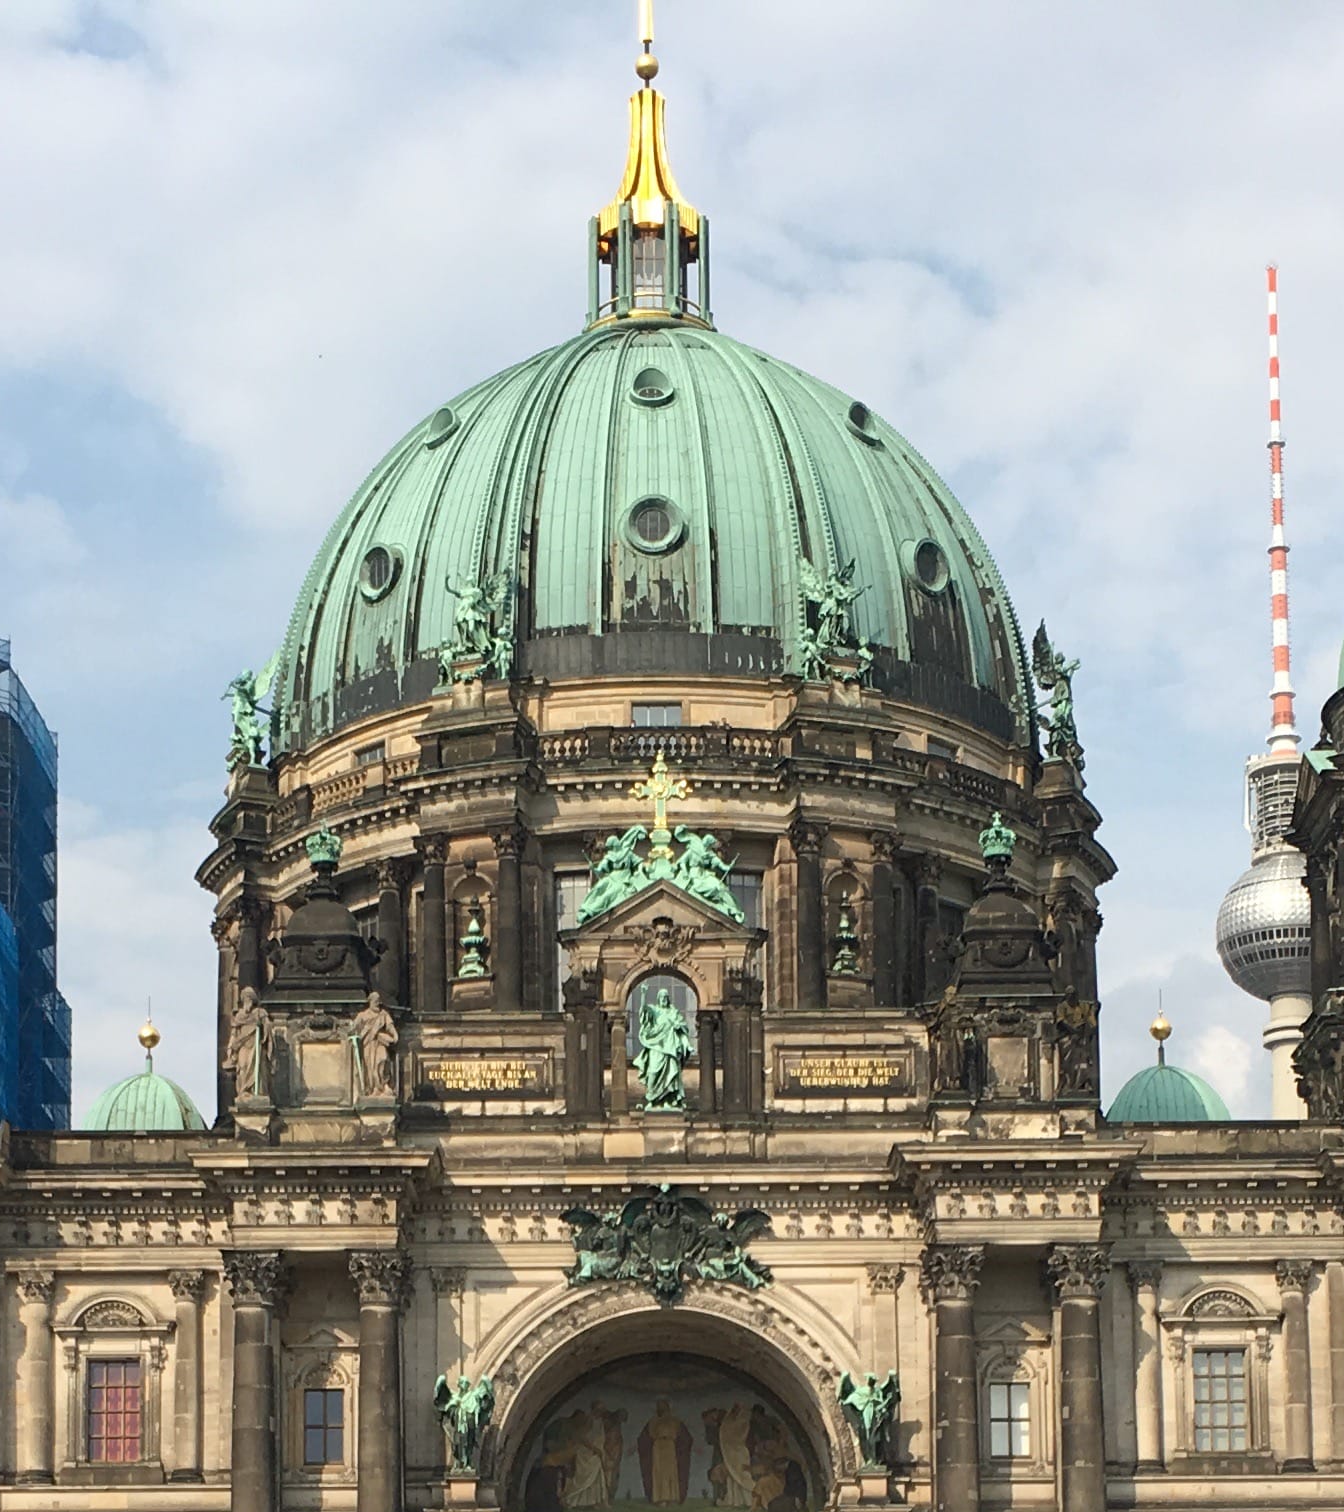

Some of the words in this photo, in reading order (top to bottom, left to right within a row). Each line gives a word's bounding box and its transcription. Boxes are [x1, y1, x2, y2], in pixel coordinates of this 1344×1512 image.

[790, 1068, 808, 1076] DER
[836, 1068, 854, 1076] DER
[876, 1068, 899, 1076] WELT
